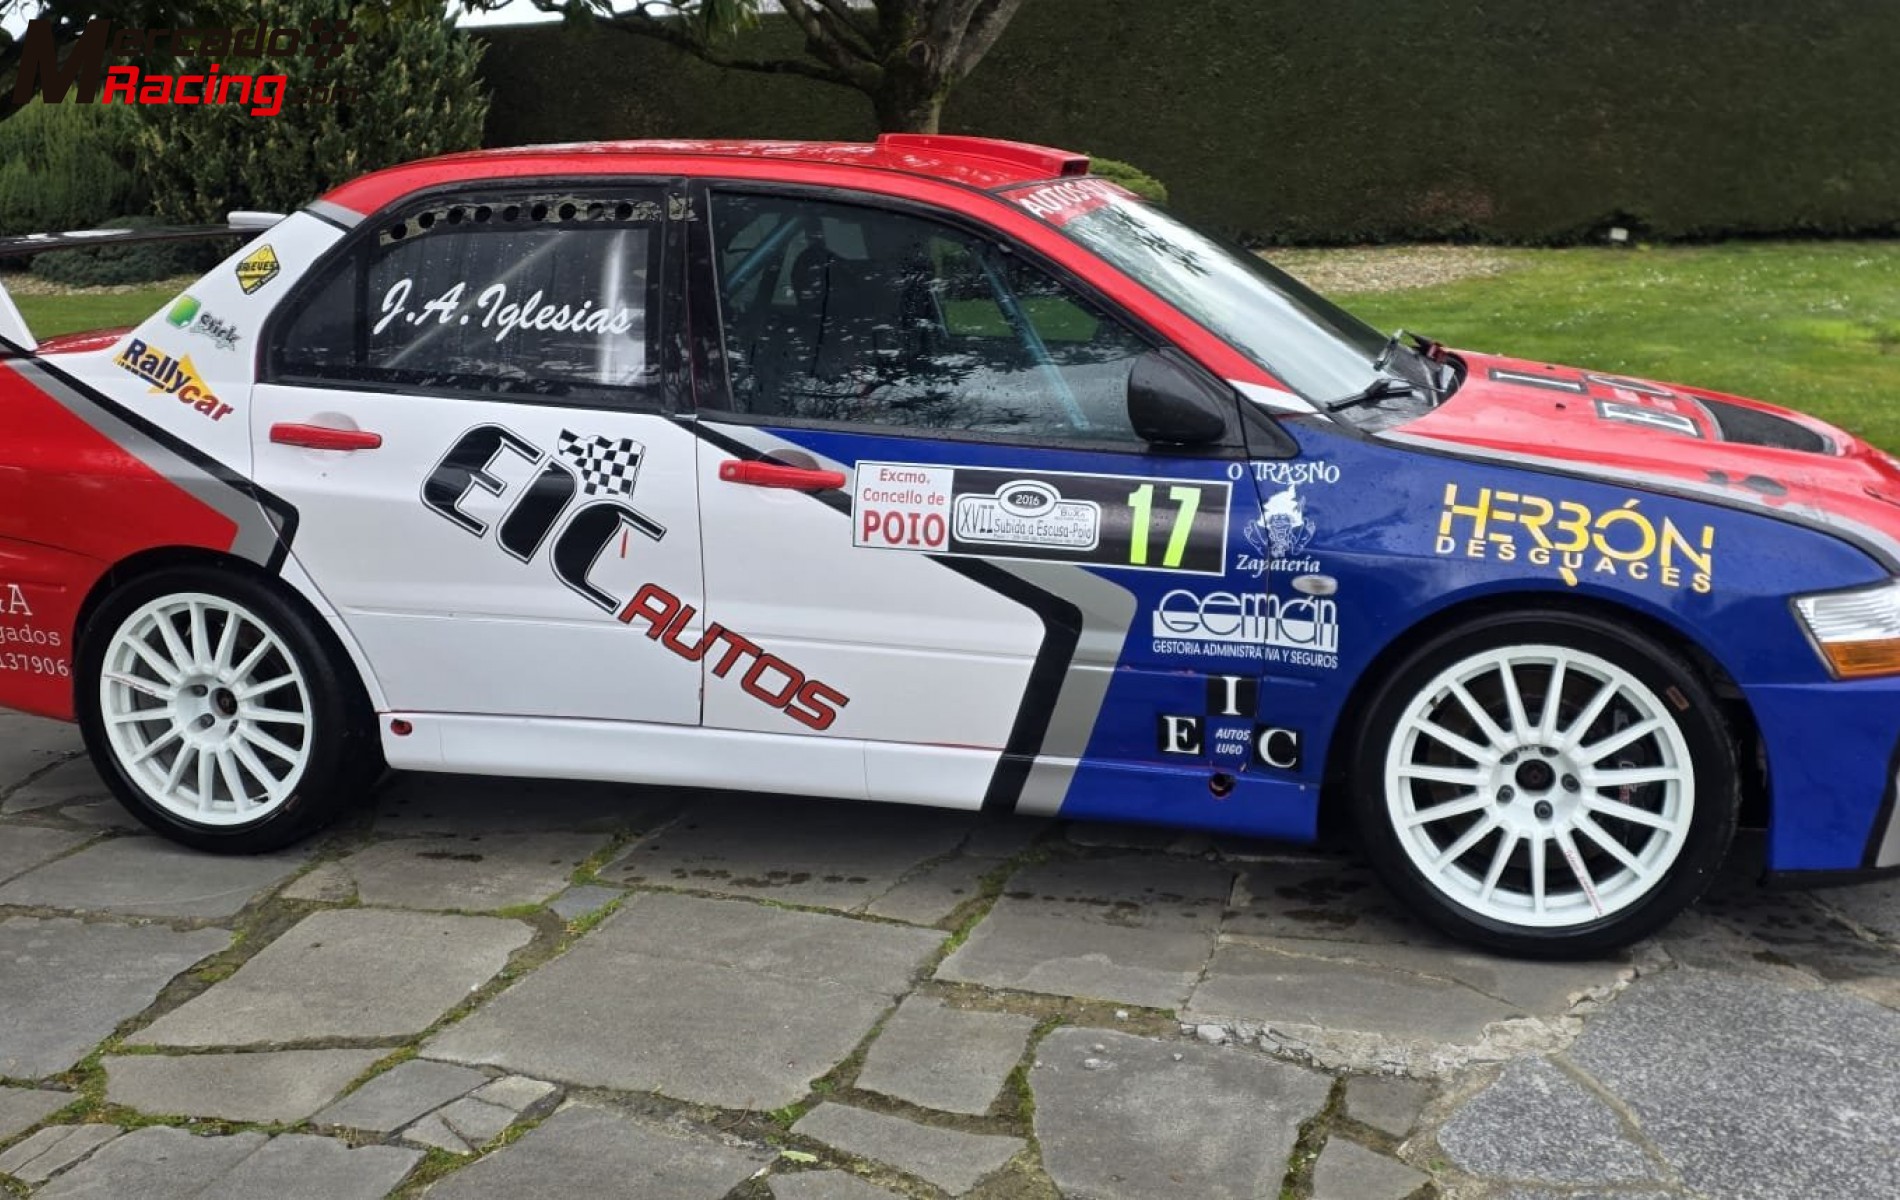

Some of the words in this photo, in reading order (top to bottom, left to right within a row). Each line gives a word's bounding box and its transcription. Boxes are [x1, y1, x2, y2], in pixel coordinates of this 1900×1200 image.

[122, 337, 235, 421] Rallycar
[880, 468, 931, 484] Excmo.
[863, 487, 923, 504] Concello
[927, 492, 945, 505] de
[1015, 494, 1041, 506] 2016
[863, 510, 946, 547] POIO
[961, 503, 995, 534] XVII
[994, 518, 1026, 535] Subida
[1028, 523, 1035, 535] a
[1128, 484, 1201, 567] 17
[1440, 483, 1714, 577] HERBÓN
[1235, 554, 1322, 579] Zapatería
[1435, 536, 1713, 593] DESGUACES
[617, 582, 850, 731] AUTOS
[1282, 650, 1290, 662] Y
[1290, 652, 1338, 669] SEGUROS
[1215, 727, 1250, 742] AUTOS
[1215, 743, 1244, 755] LUGO
